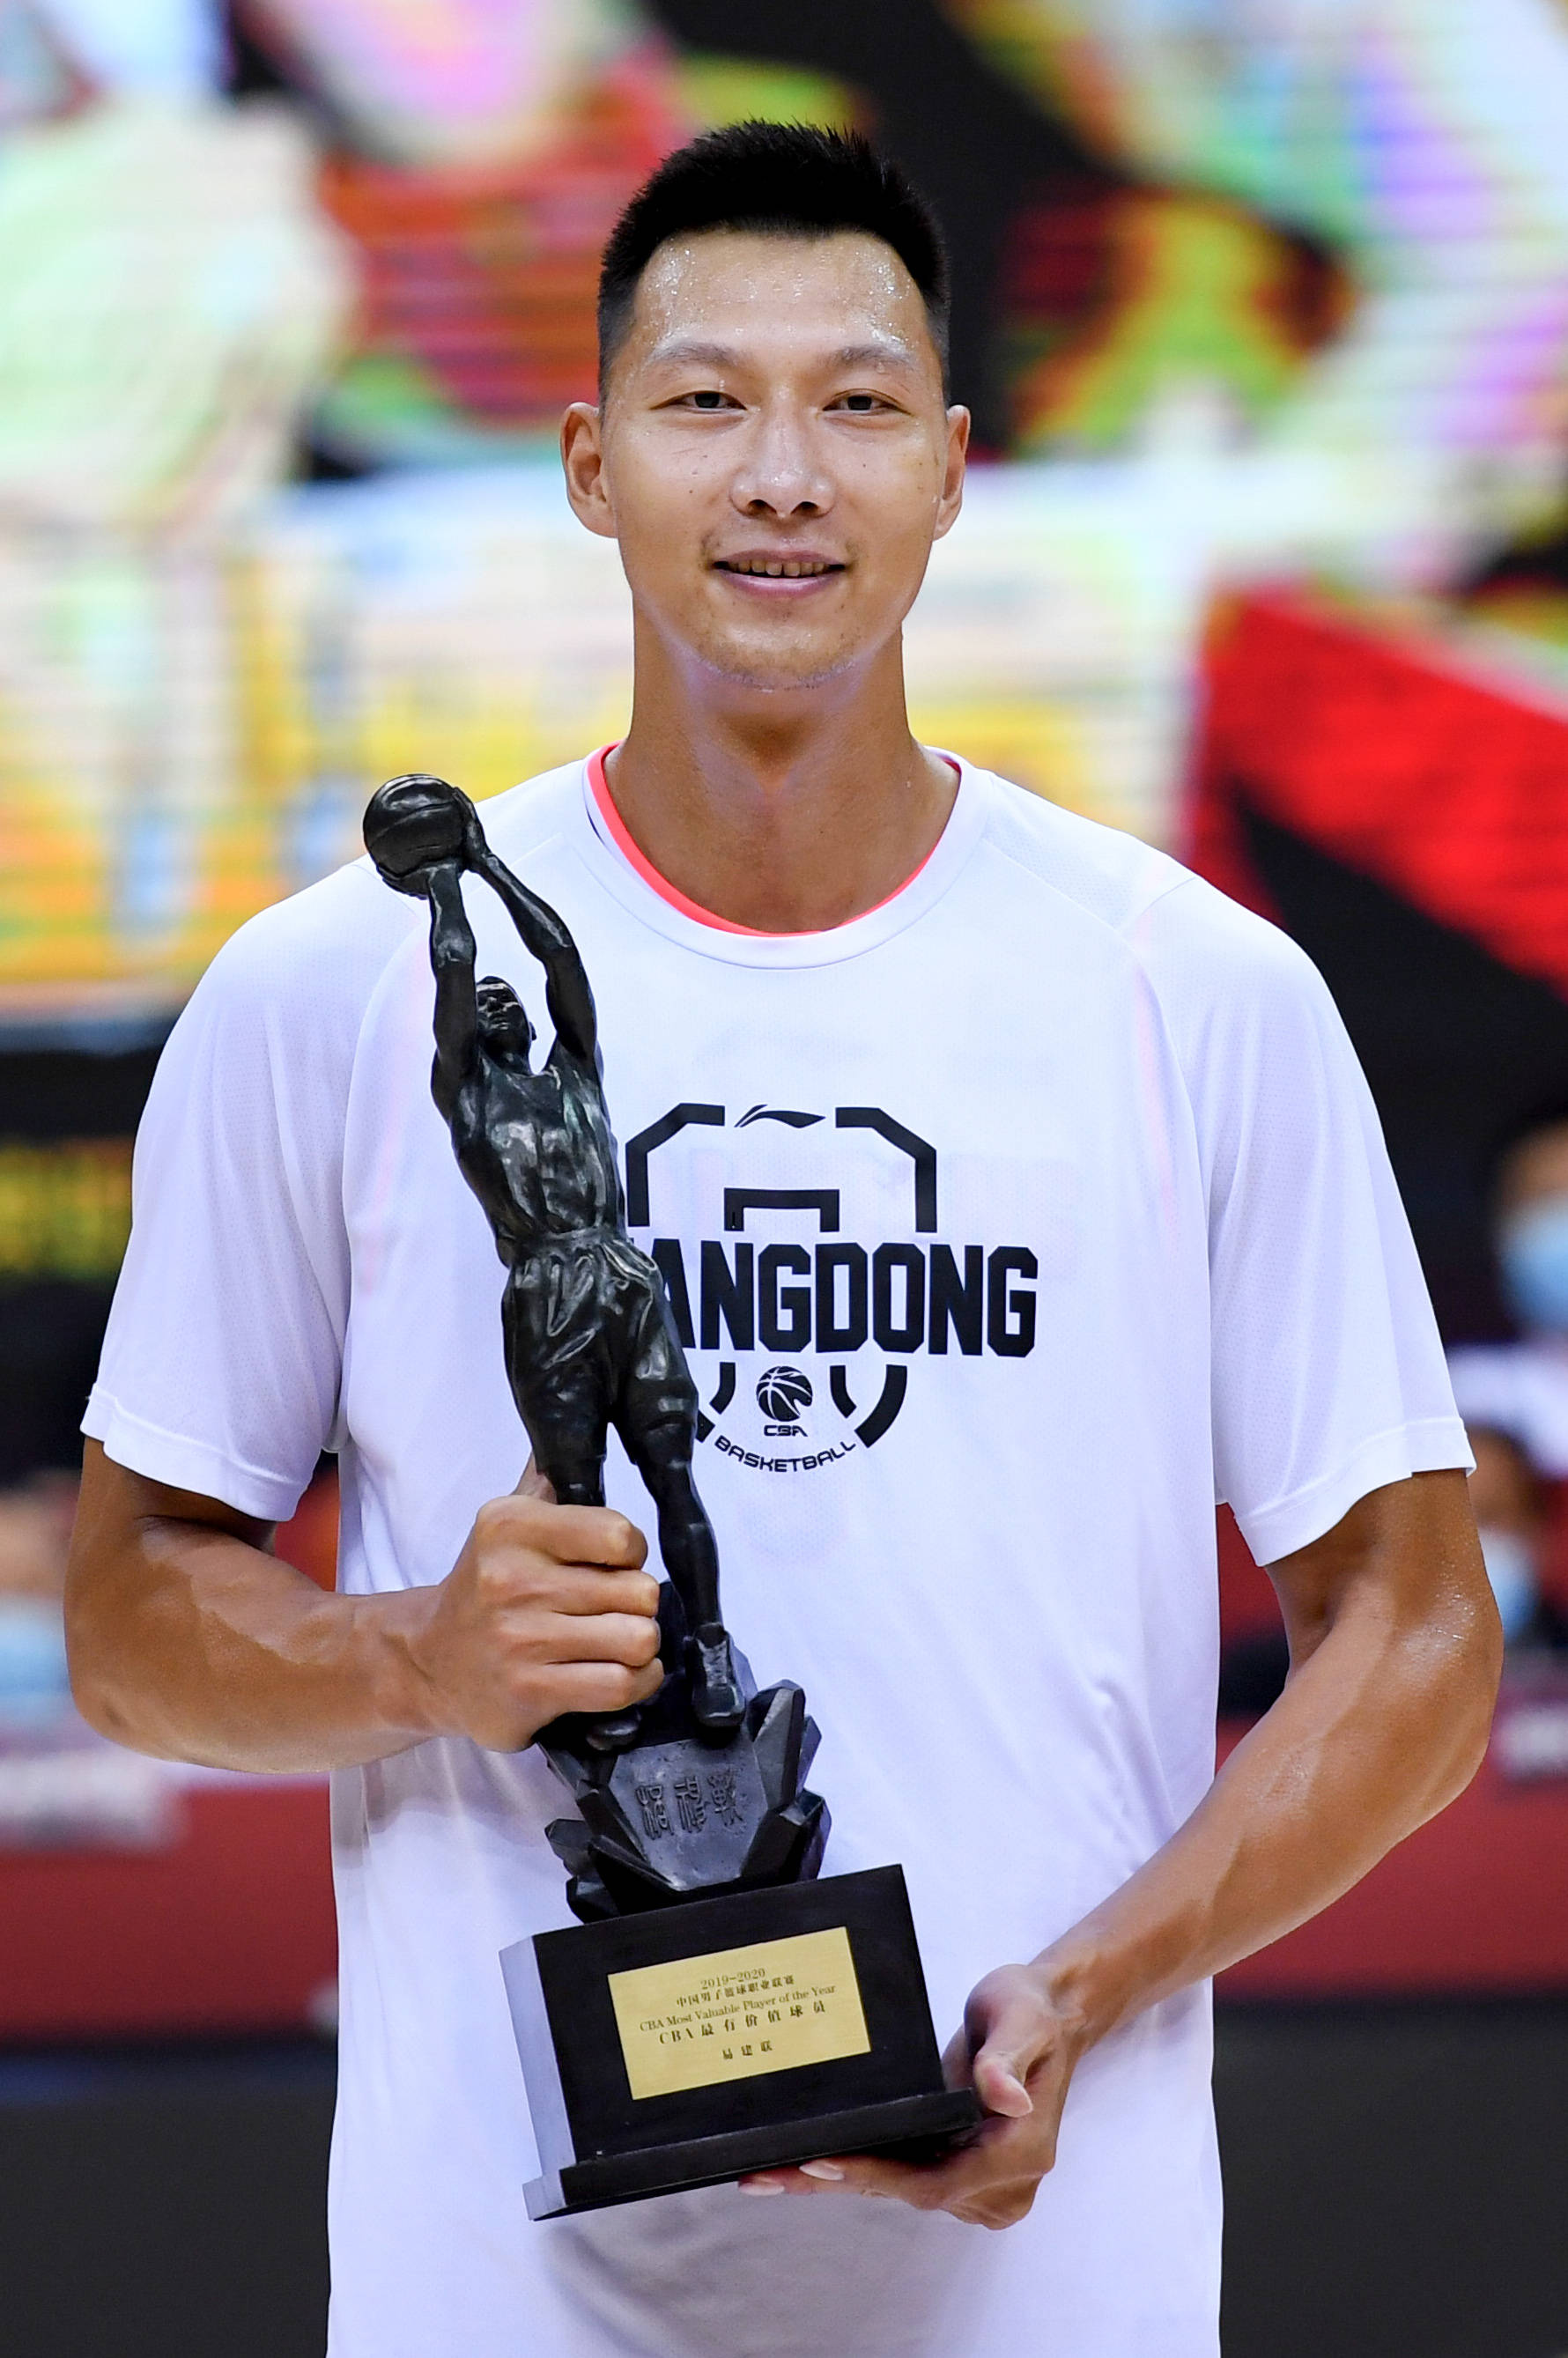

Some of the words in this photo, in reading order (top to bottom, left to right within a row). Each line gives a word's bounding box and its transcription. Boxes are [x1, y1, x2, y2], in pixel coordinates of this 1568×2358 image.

[650, 1238, 1039, 1357] ANGDONG
[764, 1425, 809, 1438] CBA
[714, 1435, 856, 1472] BASKETBALL
[677, 1975, 794, 2007] 中国男子篮球职业联赛
[700, 1968, 766, 1990] 2019-2020
[640, 2019, 664, 2031] CBA
[666, 2014, 692, 2026] Most
[695, 2004, 740, 2020] Valuable
[743, 1998, 776, 2011] Player
[779, 1992, 790, 2003] of
[792, 1991, 809, 2001] the
[811, 1985, 836, 1997] Year
